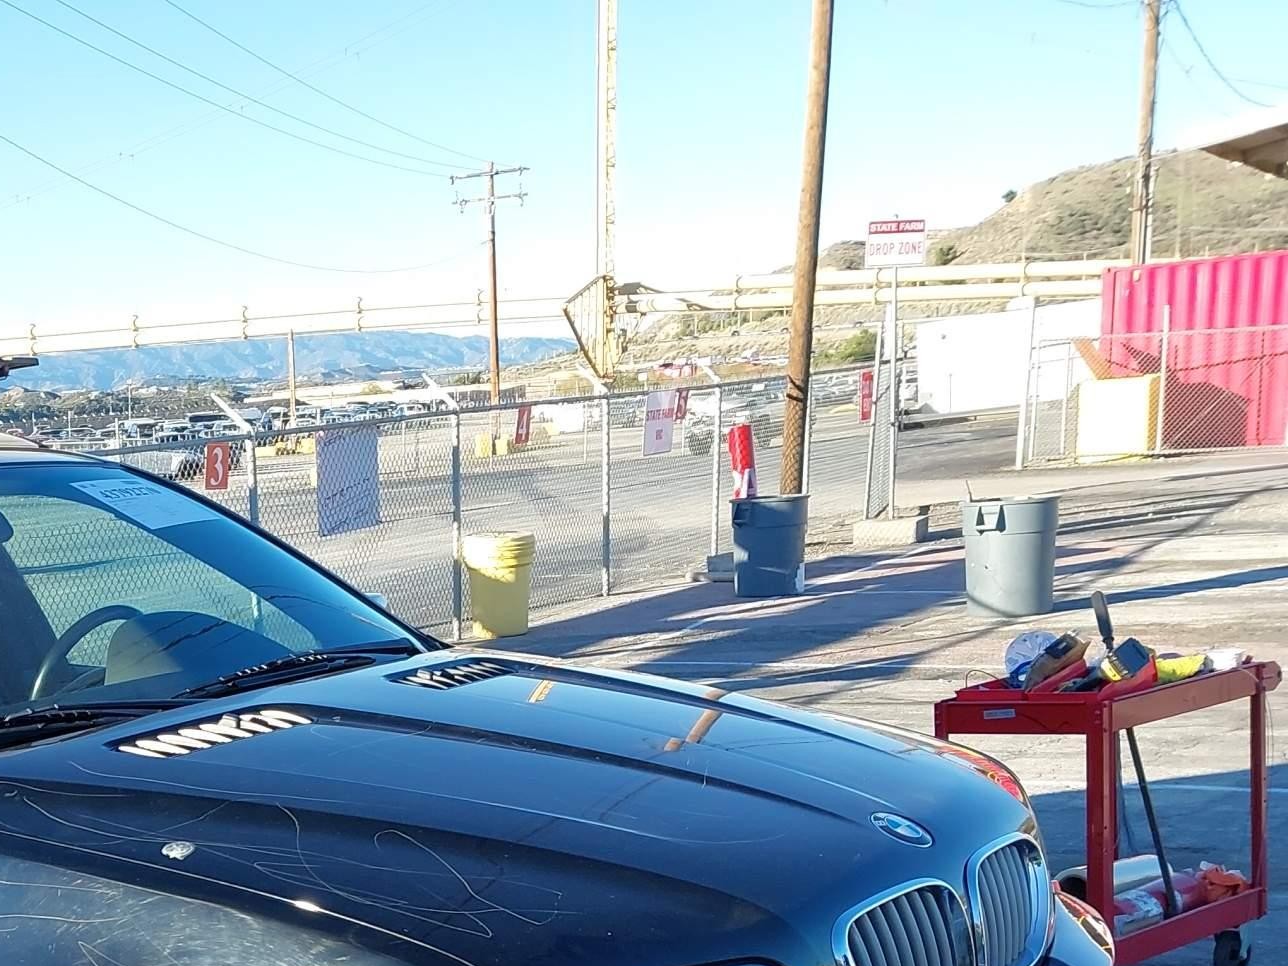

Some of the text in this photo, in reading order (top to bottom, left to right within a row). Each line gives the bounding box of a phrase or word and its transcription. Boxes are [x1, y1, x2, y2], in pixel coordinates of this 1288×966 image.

[870, 221, 924, 233] STATE FARM
[869, 240, 923, 256] DROP ZONE
[518, 410, 528, 441] 4
[210, 446, 223, 486] 3
